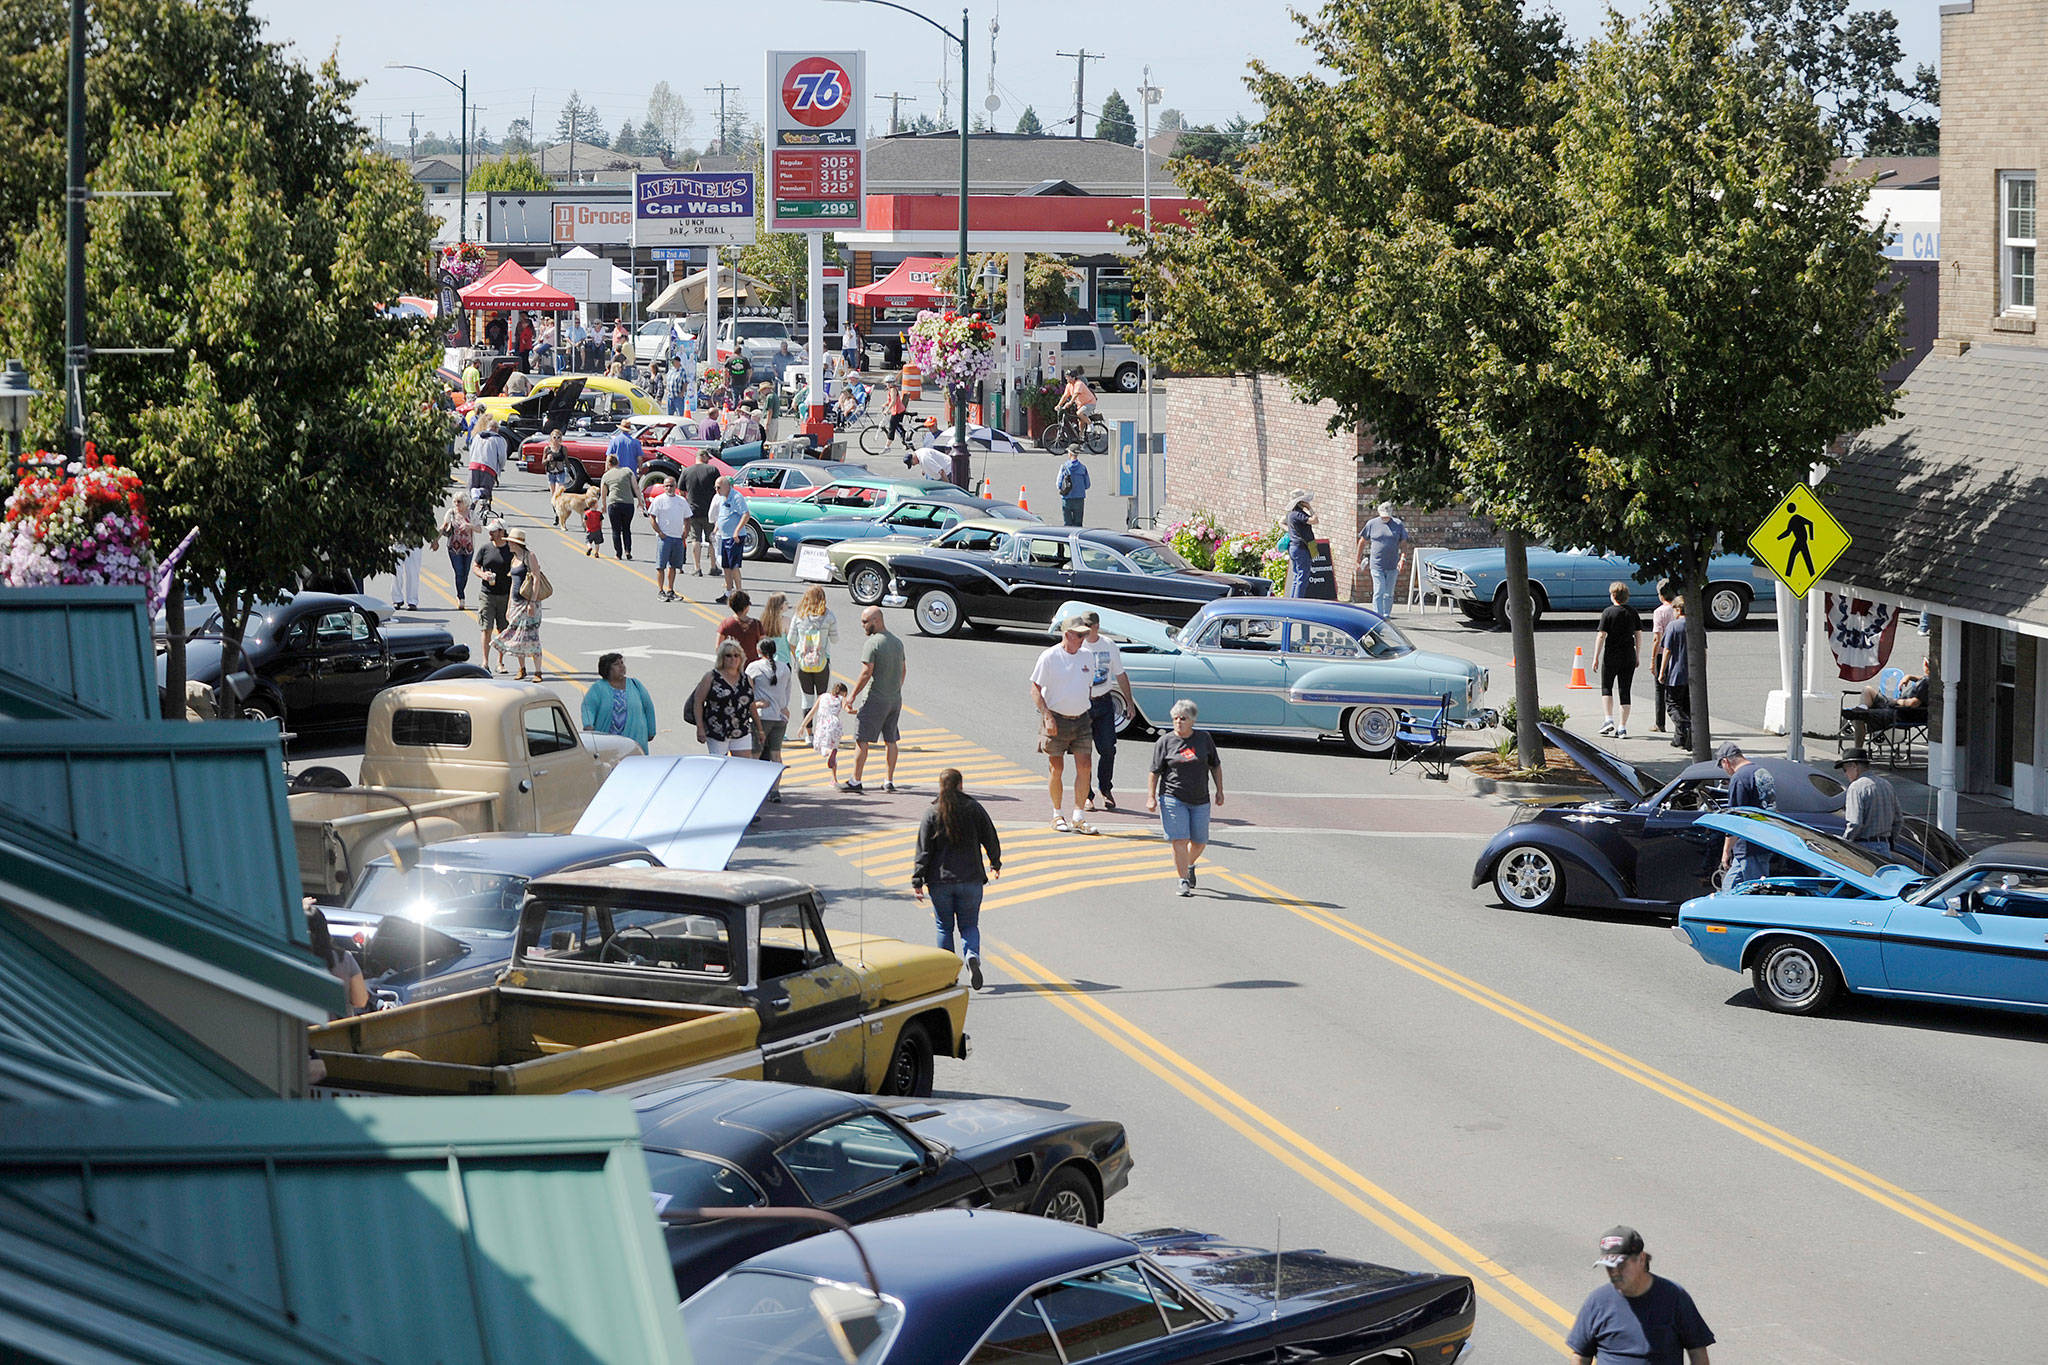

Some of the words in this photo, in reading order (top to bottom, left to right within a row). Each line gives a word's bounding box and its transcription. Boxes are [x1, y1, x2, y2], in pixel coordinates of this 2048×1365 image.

[792, 69, 843, 111] 76
[640, 178, 748, 200] KETTEL'S
[578, 207, 632, 224] Groce
[645, 202, 682, 214] Car
[688, 201, 743, 213] Wash
